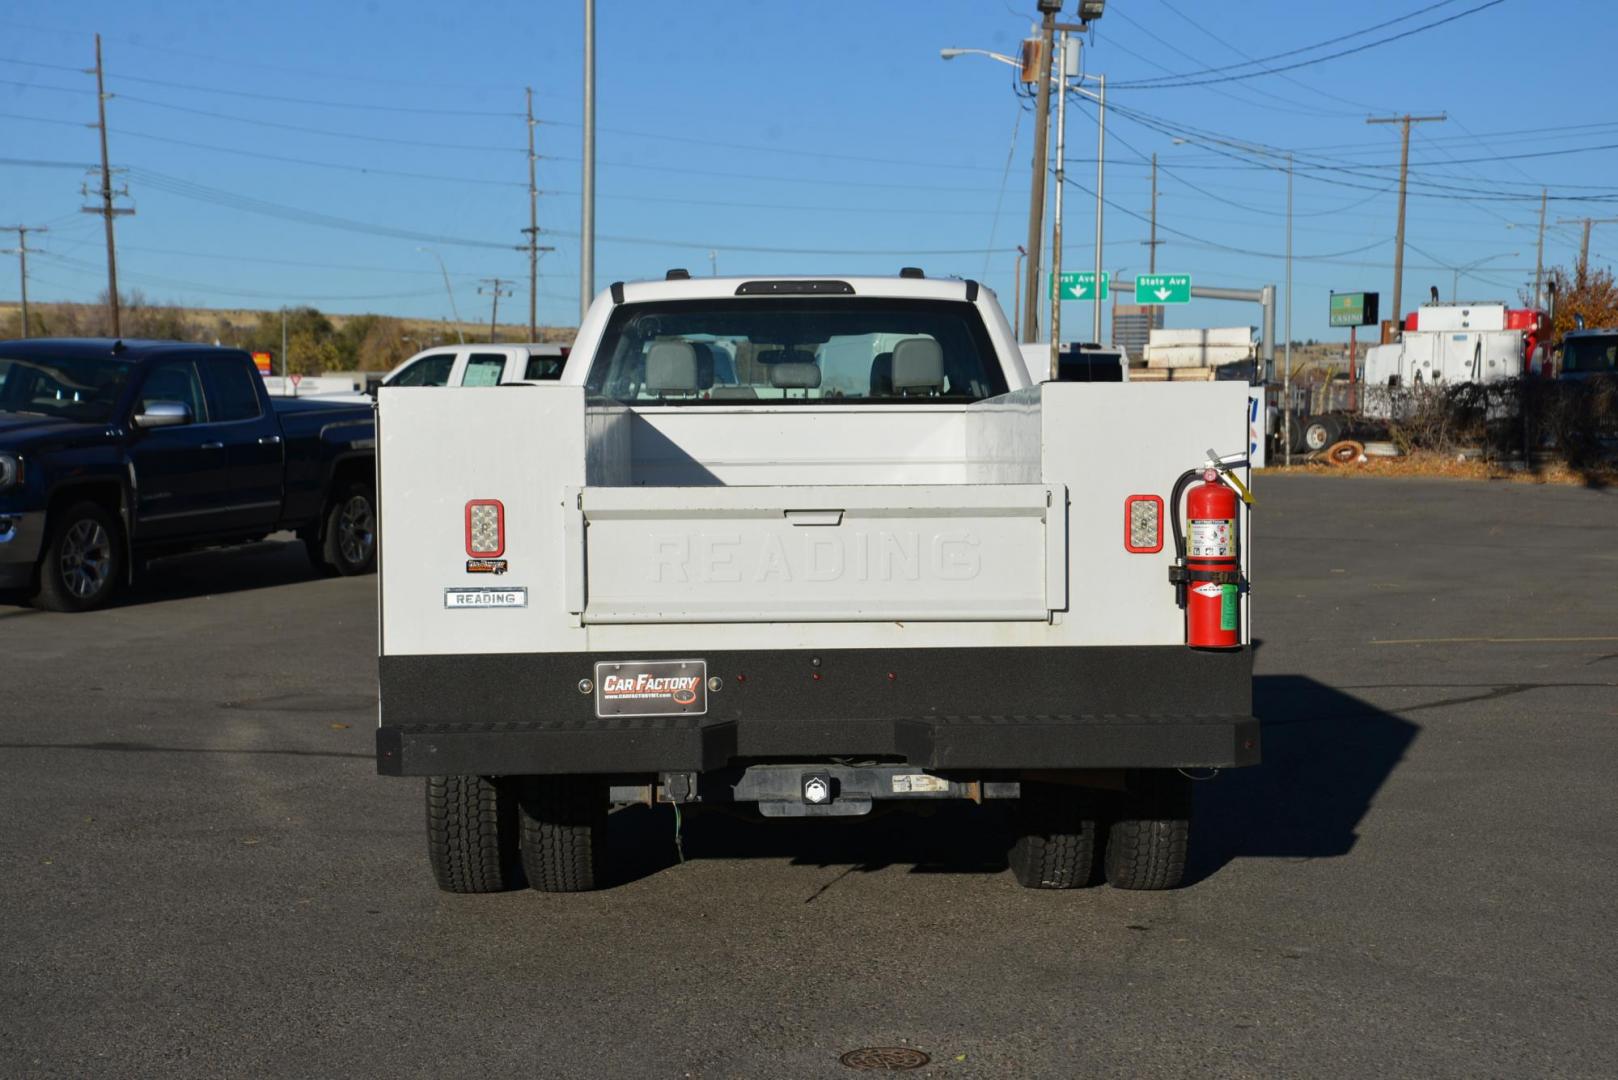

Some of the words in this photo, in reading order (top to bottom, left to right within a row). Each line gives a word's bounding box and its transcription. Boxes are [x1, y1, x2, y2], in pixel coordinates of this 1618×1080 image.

[1079, 275, 1093, 283] Ave
[1140, 277, 1165, 286] State
[1169, 277, 1186, 285] Ave
[650, 531, 982, 583] READING
[456, 593, 516, 604] READING
[603, 675, 633, 692] CAR
[635, 672, 698, 691] FACTORY
